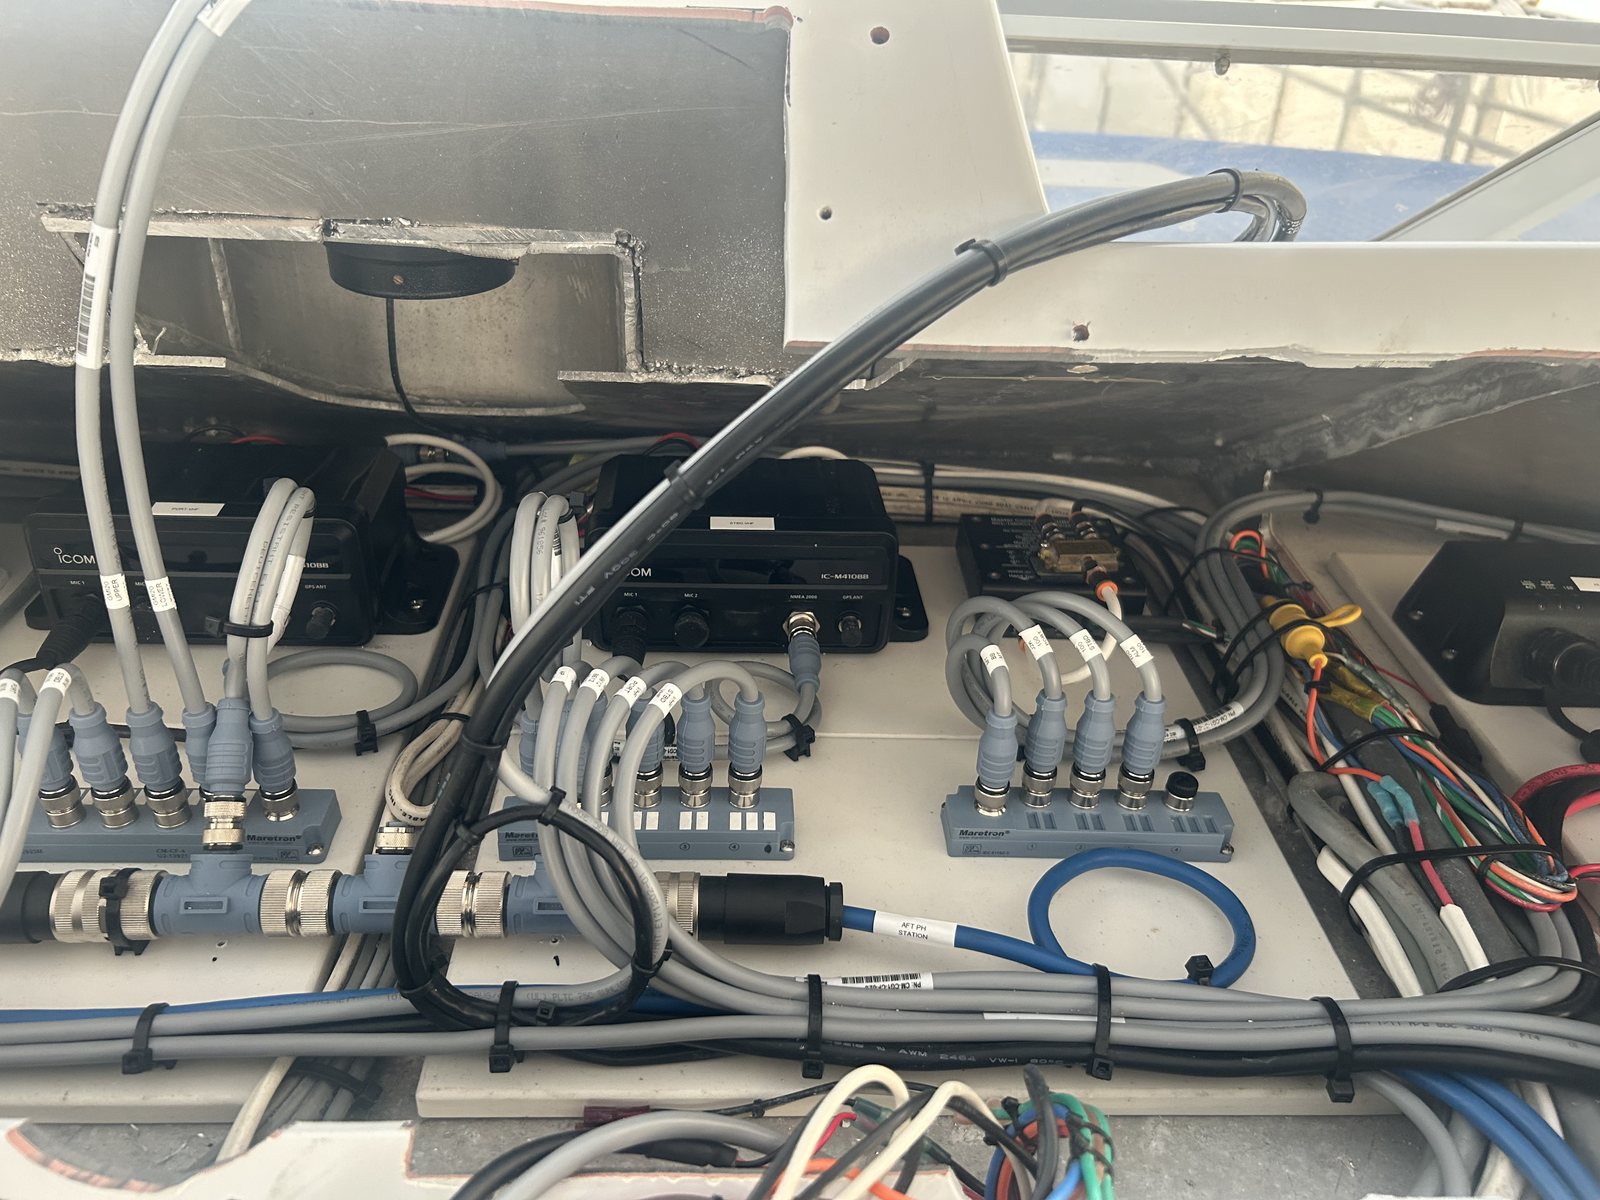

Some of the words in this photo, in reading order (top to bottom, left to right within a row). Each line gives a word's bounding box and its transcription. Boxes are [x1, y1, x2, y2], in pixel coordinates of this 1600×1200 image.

[111, 578, 123, 601] UPPER
[156, 582, 168, 608] LOWER
[1033, 636, 1042, 647] 100
[1078, 641, 1087, 653] 100
[1136, 642, 1146, 654] 100
[624, 680, 638, 694] PORT
[660, 689, 674, 703] STBD
[898, 930, 928, 940] STATION
[898, 1049, 928, 1057] AWM
